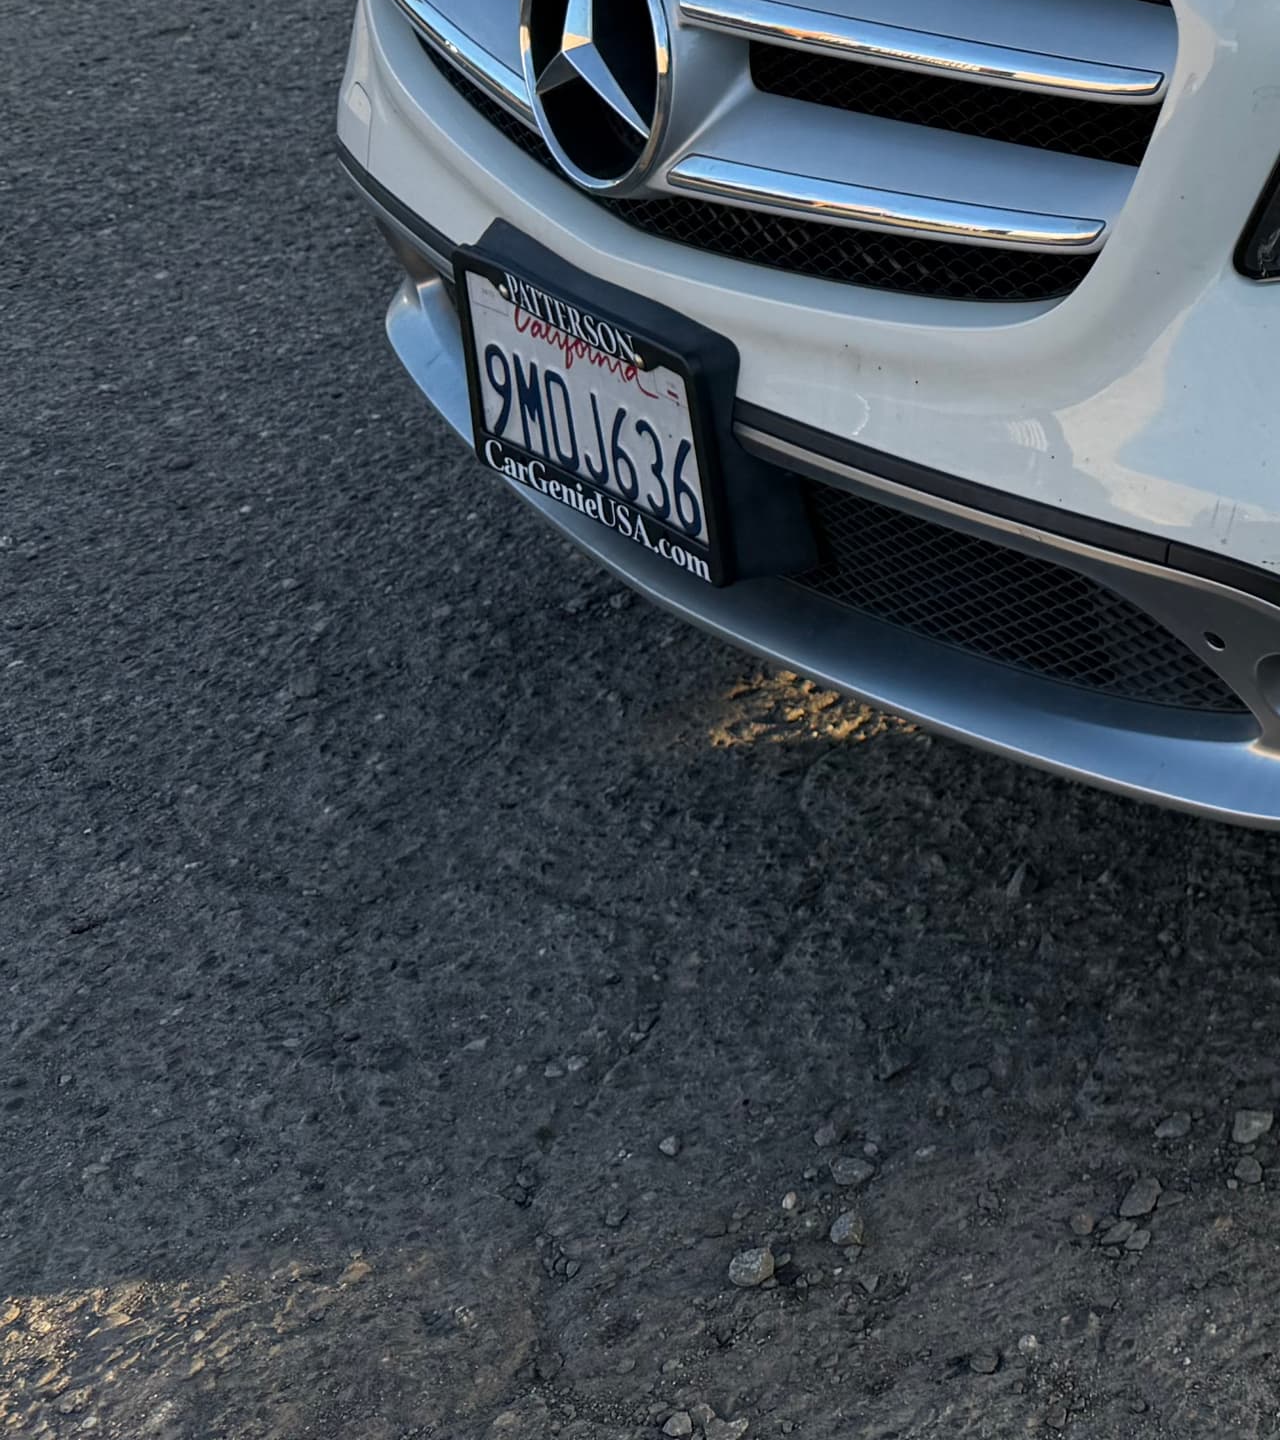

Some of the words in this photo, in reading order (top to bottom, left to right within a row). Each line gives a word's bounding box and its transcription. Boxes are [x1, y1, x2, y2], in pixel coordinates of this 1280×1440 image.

[503, 272, 635, 361] PATTERSON
[514, 305, 659, 400] California
[485, 343, 702, 537] 9MDJ636
[485, 439, 713, 583] CarGenieUSA.com
